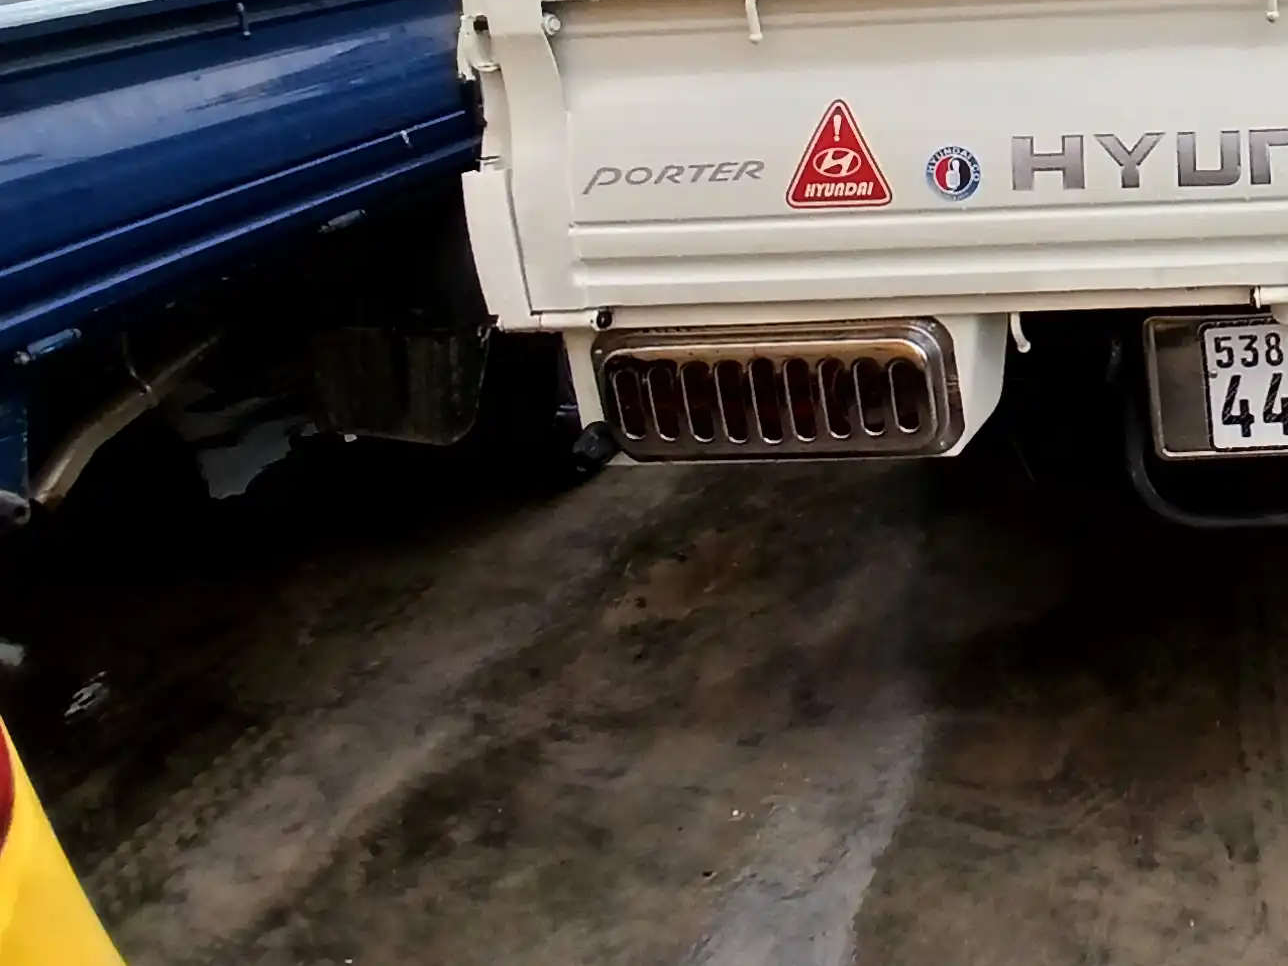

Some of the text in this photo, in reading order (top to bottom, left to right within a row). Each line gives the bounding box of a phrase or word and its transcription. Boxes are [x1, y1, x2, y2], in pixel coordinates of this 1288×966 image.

[582, 160, 765, 195] PORTER
[804, 182, 874, 199] HYUNDAI
[1213, 333, 1284, 369] 538
